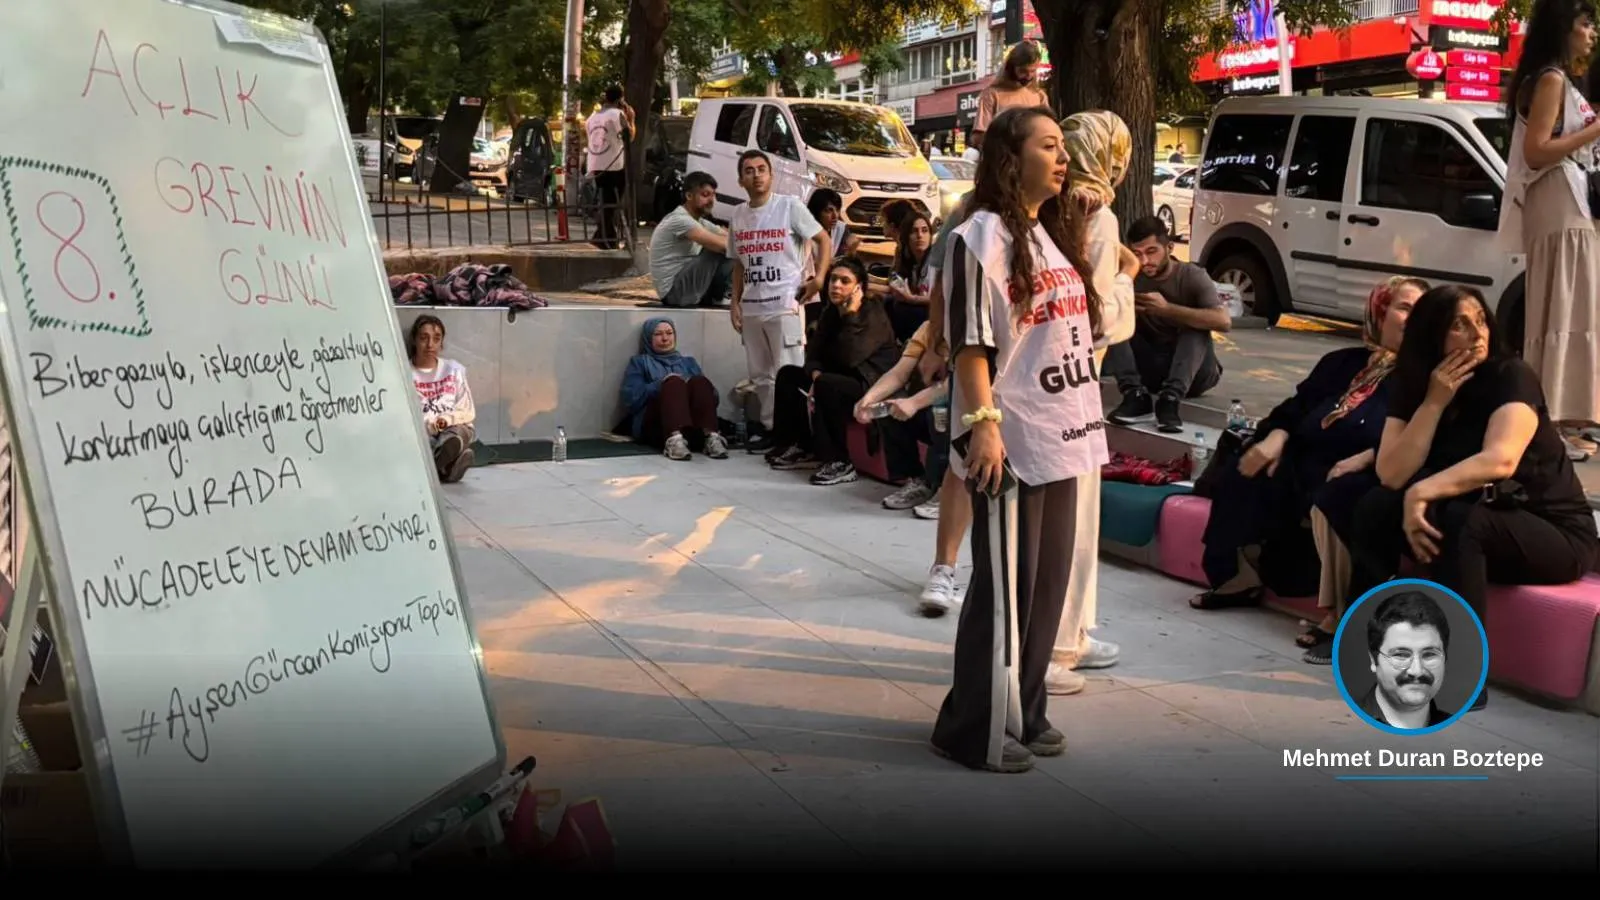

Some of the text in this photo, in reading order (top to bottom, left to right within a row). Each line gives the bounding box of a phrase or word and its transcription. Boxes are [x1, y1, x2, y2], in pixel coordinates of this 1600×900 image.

[82, 29, 303, 137] AÇLIK
[36, 190, 117, 303] 8.
[154, 156, 348, 248] GREVİNİN
[218, 244, 338, 311] GÜNÜ
[131, 456, 302, 530] BURADA
